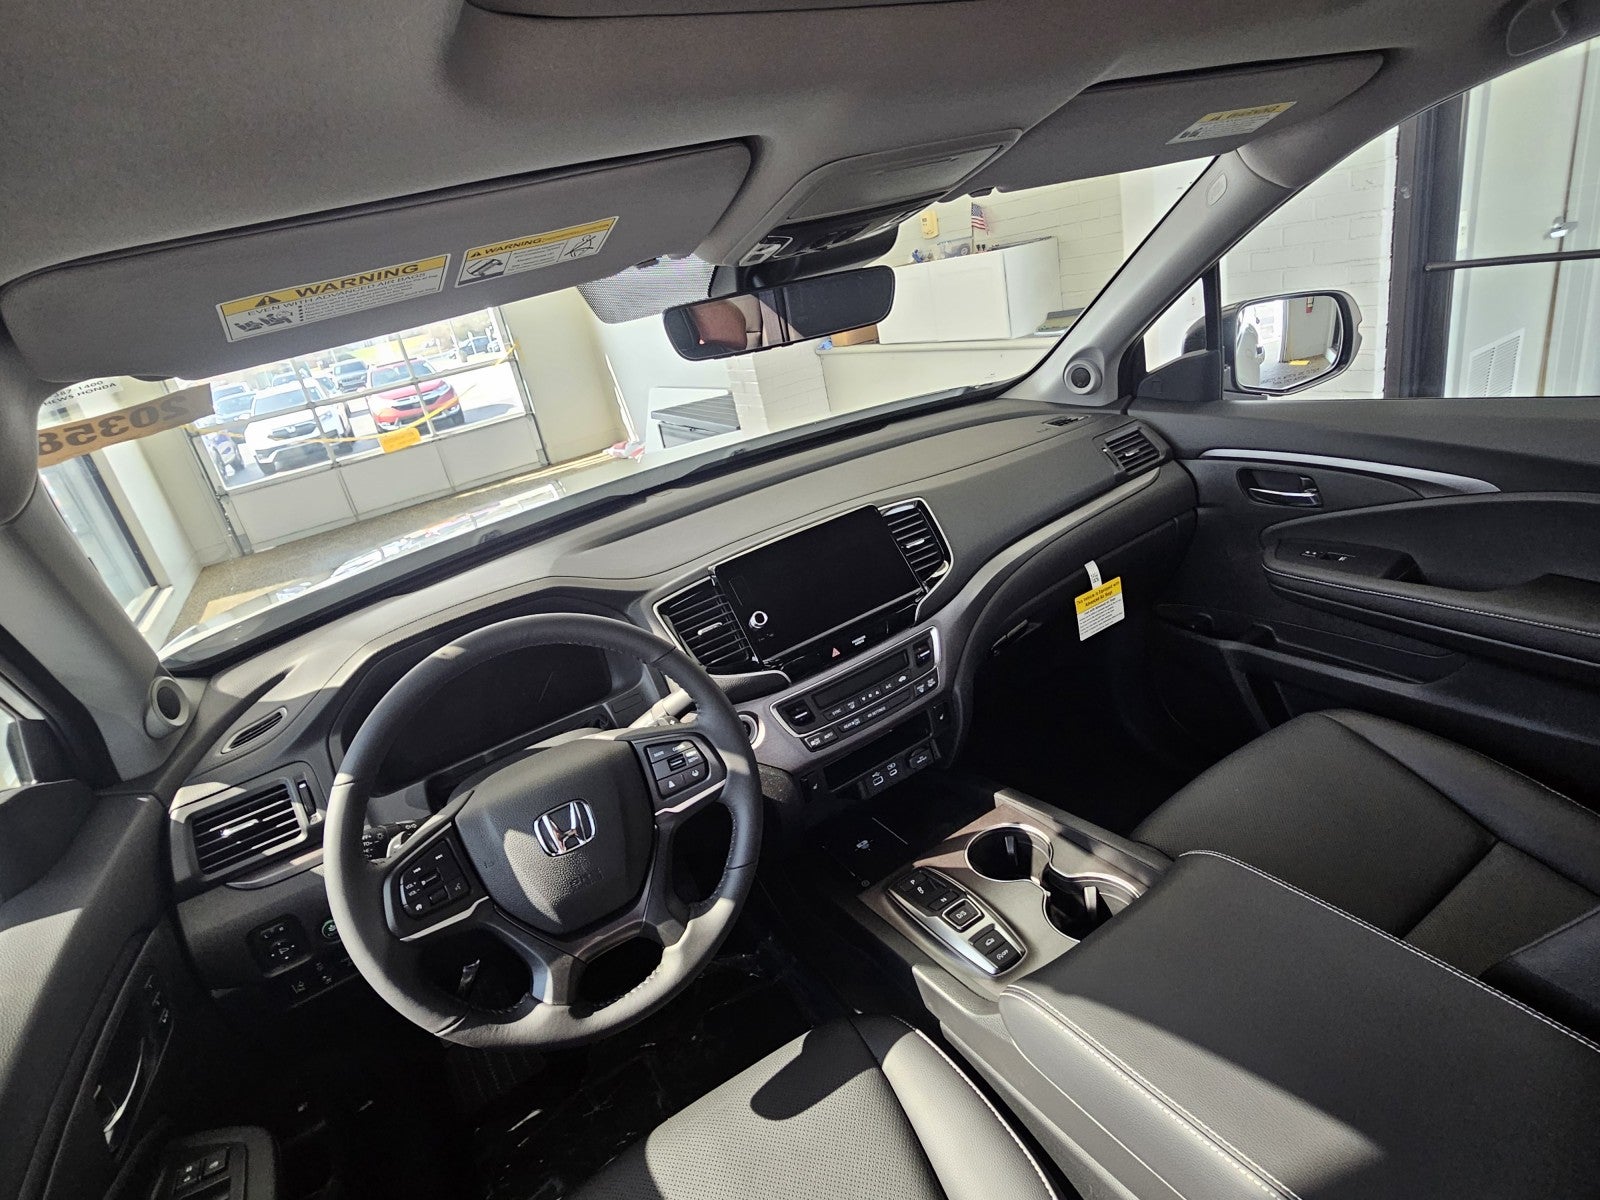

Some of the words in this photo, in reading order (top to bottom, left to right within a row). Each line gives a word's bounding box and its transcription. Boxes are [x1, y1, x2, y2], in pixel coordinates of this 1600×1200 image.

[247, 304, 280, 316] EVEN
[283, 297, 313, 309] WITH
[317, 283, 375, 301] ADVANCED
[377, 279, 395, 287] AIR
[295, 264, 419, 298] WARNING
[77, 382, 117, 396] HONDA
